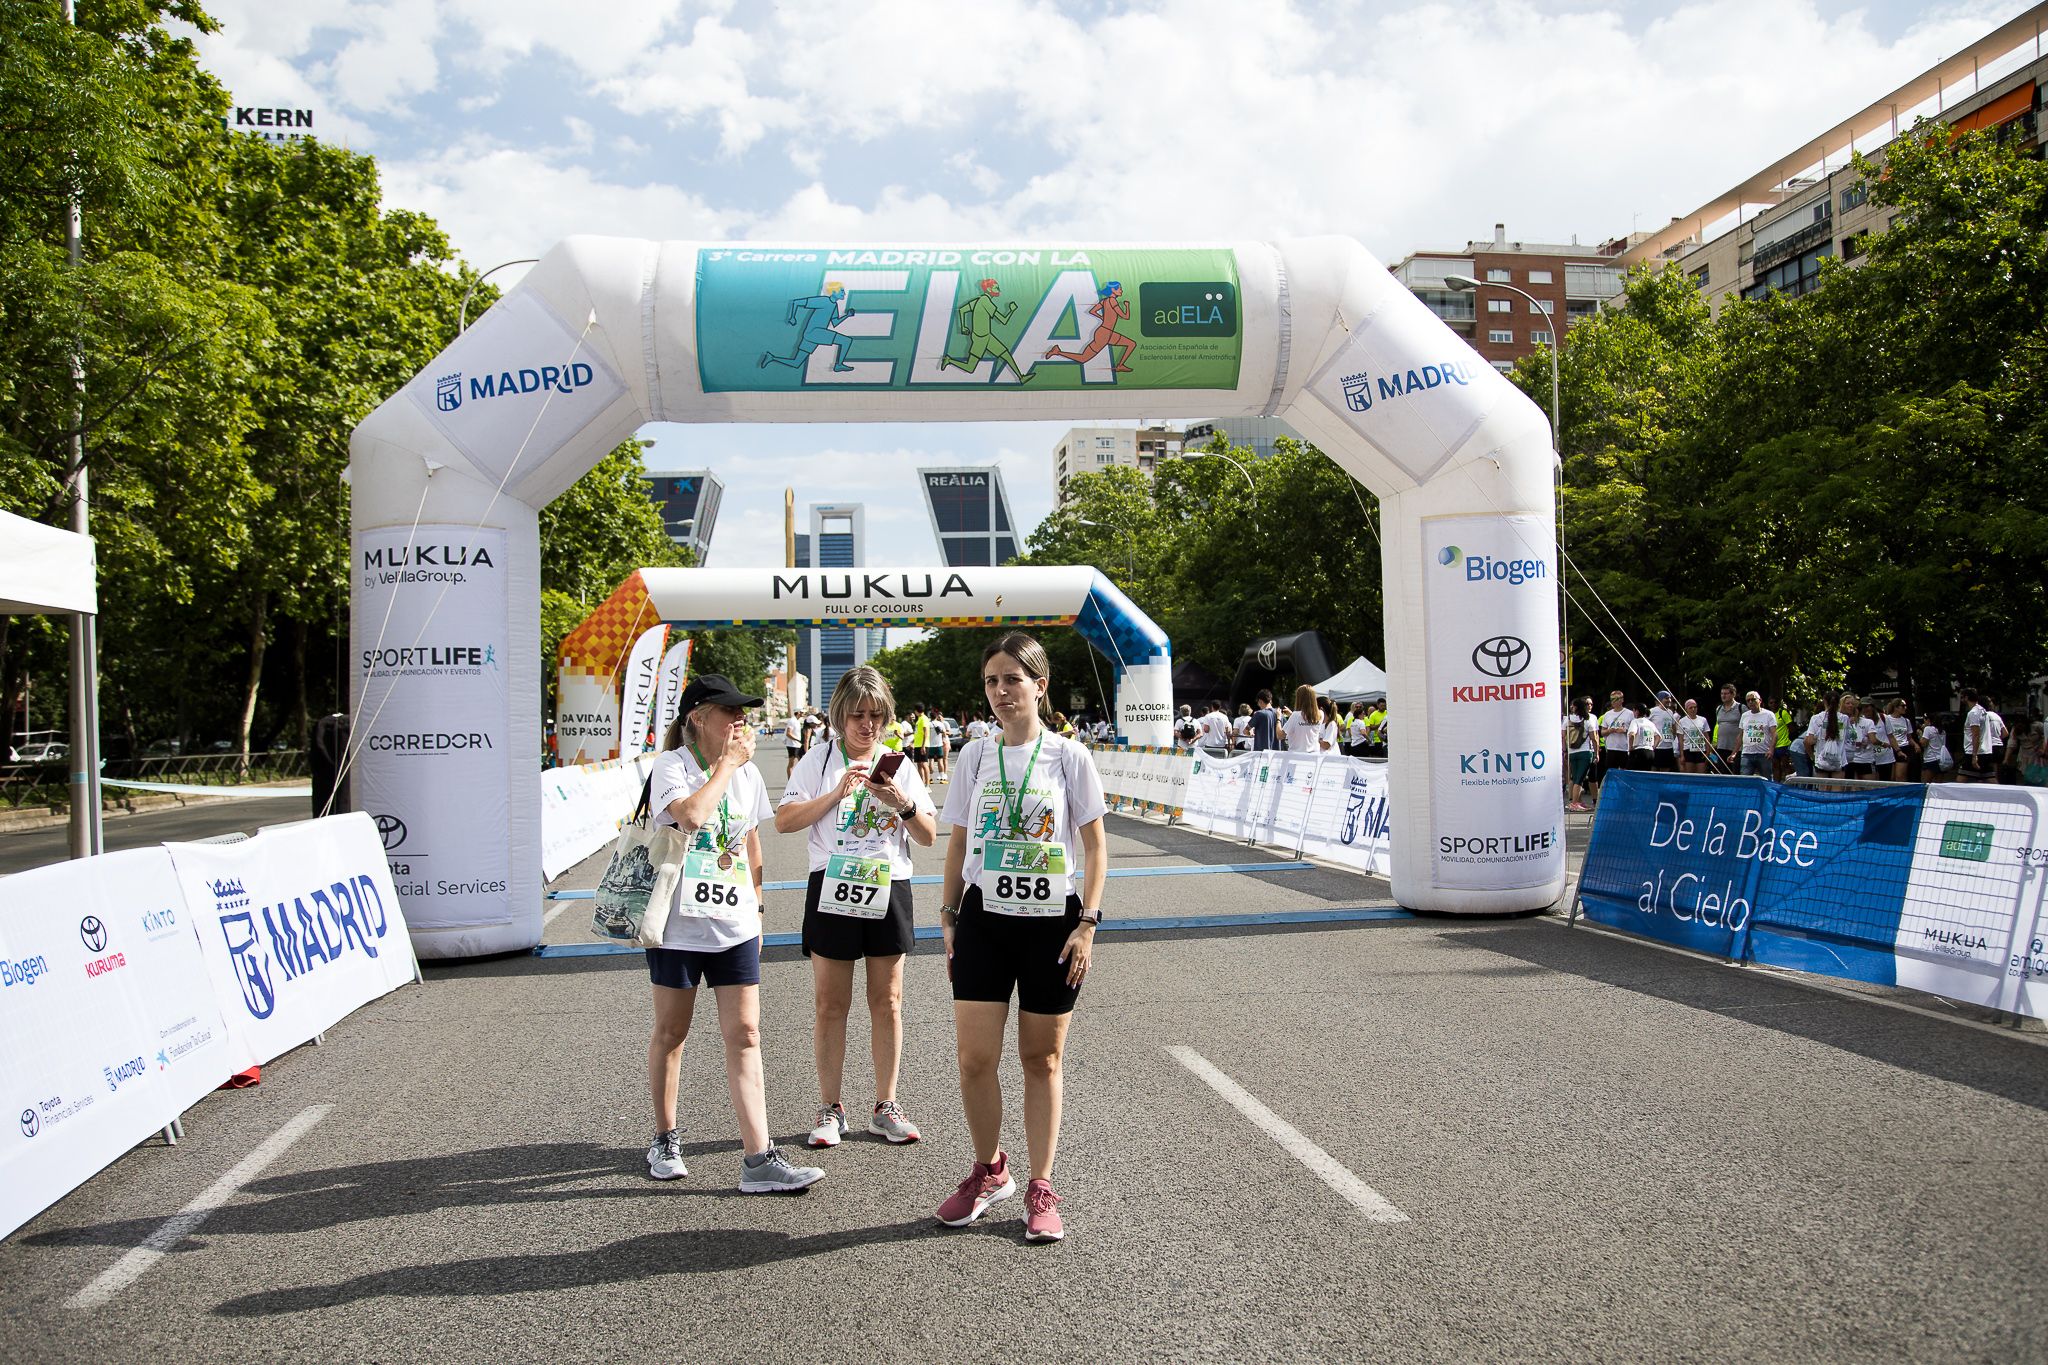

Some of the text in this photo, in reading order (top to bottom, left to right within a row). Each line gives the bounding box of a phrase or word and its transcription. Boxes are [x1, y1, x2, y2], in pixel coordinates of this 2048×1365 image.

[236, 107, 313, 127] KERN
[736, 251, 818, 263] Carrera
[826, 251, 962, 266] MADRID
[970, 251, 1041, 266] CON
[1050, 251, 1092, 266] LA
[802, 269, 1118, 387] ELA
[1139, 353, 1174, 361] Esclerosis
[1174, 353, 1197, 361] Lateral
[1140, 343, 1219, 351] Asociación Española de
[470, 363, 593, 401] MADRID
[1377, 360, 1480, 401] MADRID
[364, 546, 495, 571] MUKUA
[1466, 555, 1546, 586] Biogen
[364, 576, 377, 589] by
[772, 573, 974, 600] MUKUA
[825, 603, 924, 614] FULL OF COLOURS
[363, 647, 482, 669] SPORTLIFE
[443, 668, 449, 676] Y
[450, 667, 481, 676] EVENTOS
[562, 713, 612, 723] DA VIDA A
[1124, 714, 1135, 723] TU
[1125, 703, 1138, 712] DA
[1138, 703, 1166, 711] COLOR
[561, 727, 612, 737] TUS PASOS
[1461, 775, 1546, 786] Flexible Mobility Solutions
[1440, 831, 1550, 855] SPORTLIFE
[1649, 802, 1819, 868] De la Base
[1000, 848, 1049, 870] ELA
[1441, 850, 1550, 864] MOVILIDAD, COMUNICACIÓN Y EVENTOS
[437, 878, 507, 896] Services
[695, 882, 739, 907] 856
[834, 882, 880, 906] 857
[996, 875, 1051, 900] 858
[1638, 869, 1750, 932] al Cielo
[262, 874, 388, 982] MADRID
[1925, 928, 1988, 951] MUKUA
[0, 954, 49, 988] Biogen
[114, 1056, 147, 1083] MADRID
[38, 1096, 62, 1113] Toyota
[45, 1106, 74, 1127] Financial
